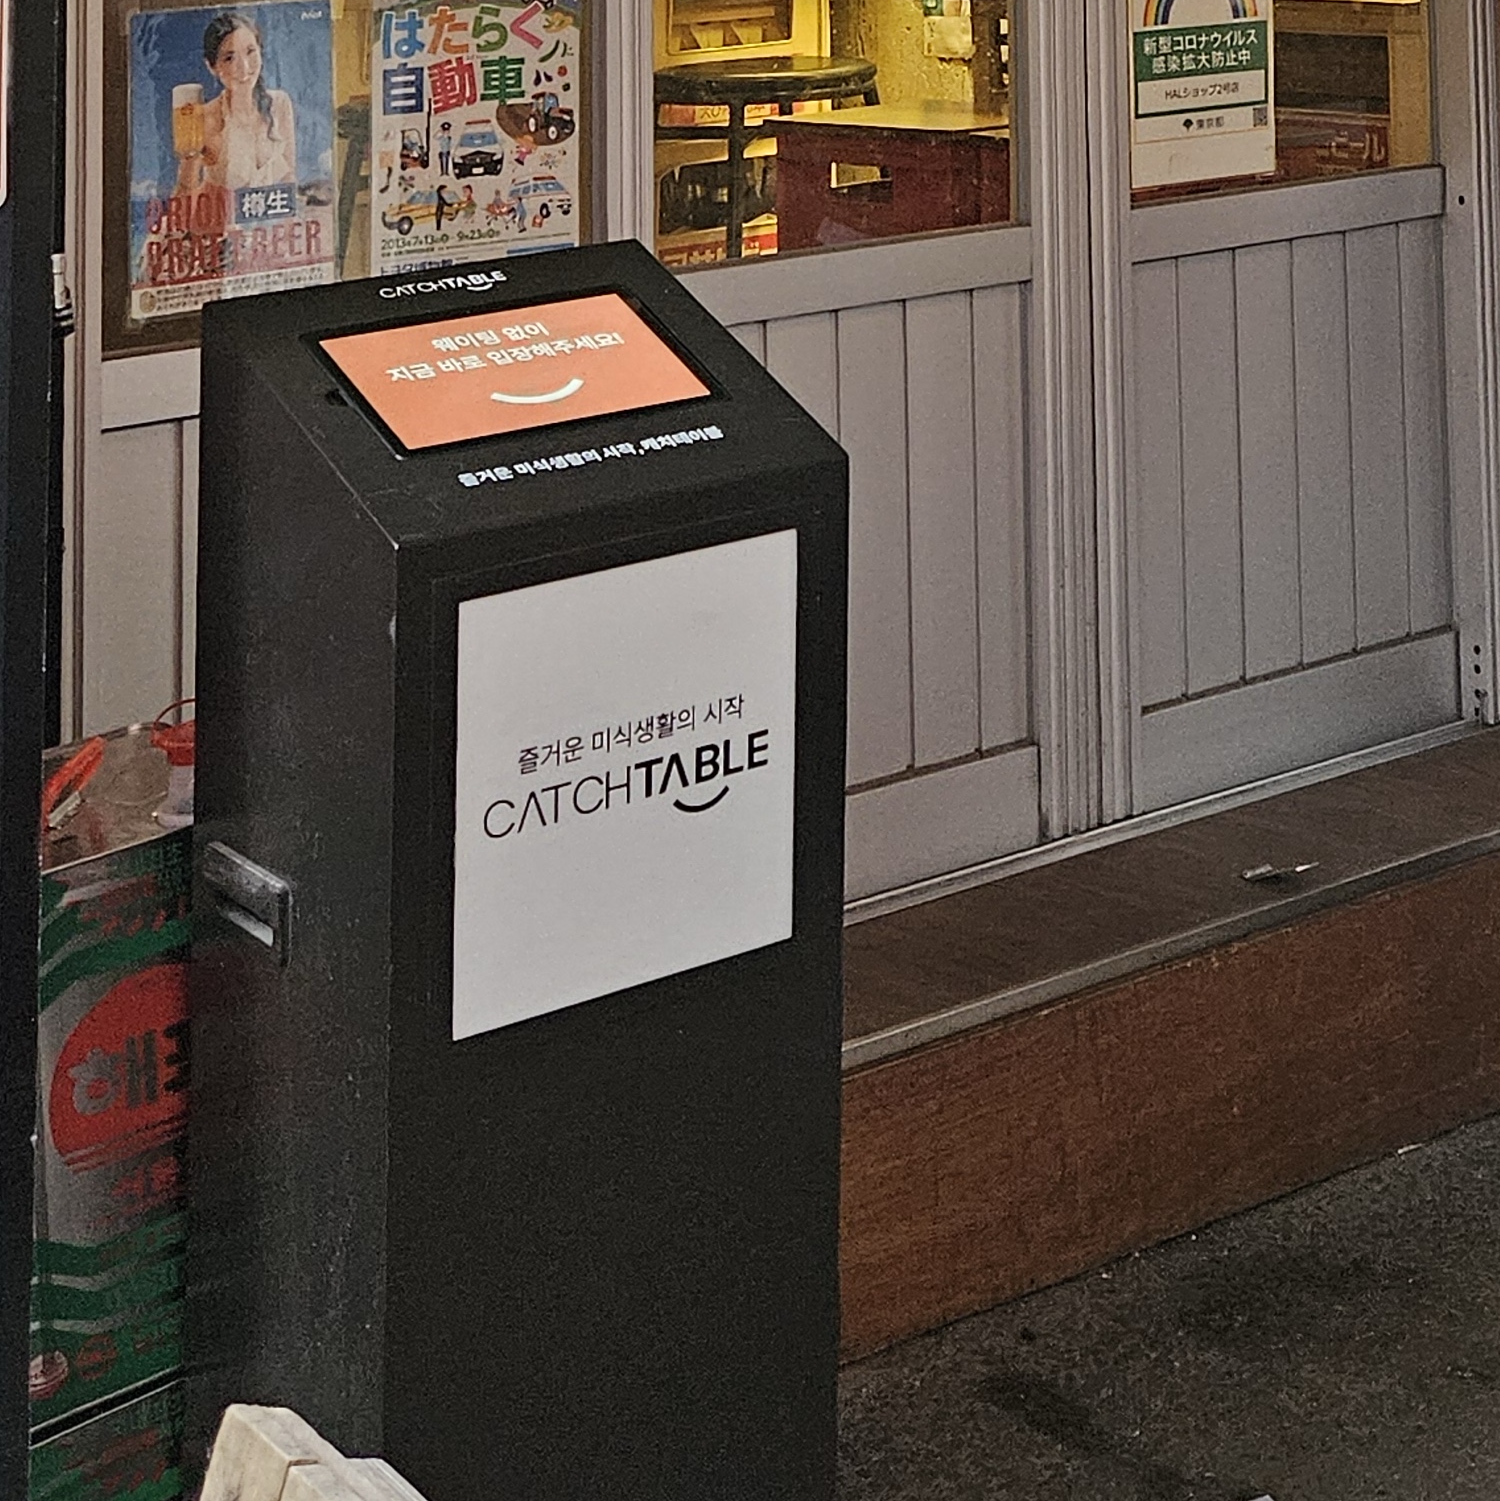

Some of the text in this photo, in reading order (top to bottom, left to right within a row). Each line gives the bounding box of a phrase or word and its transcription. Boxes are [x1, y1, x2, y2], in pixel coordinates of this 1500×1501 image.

[381, 0, 544, 61] はたらく
[1143, 28, 1259, 56] 新型コロナウイルス
[1151, 49, 1251, 75] 感染拡大防止中
[382, 54, 526, 117] 自動車
[379, 270, 508, 300] CATCHTABLE
[385, 331, 626, 384] 지금 바로 입장해주세요!
[430, 320, 550, 354] 웨이팅 없이
[456, 465, 513, 489] 즐거운
[517, 693, 745, 776] 즐거운 미식생활의 시작
[483, 728, 770, 839] CATCHTABLE
